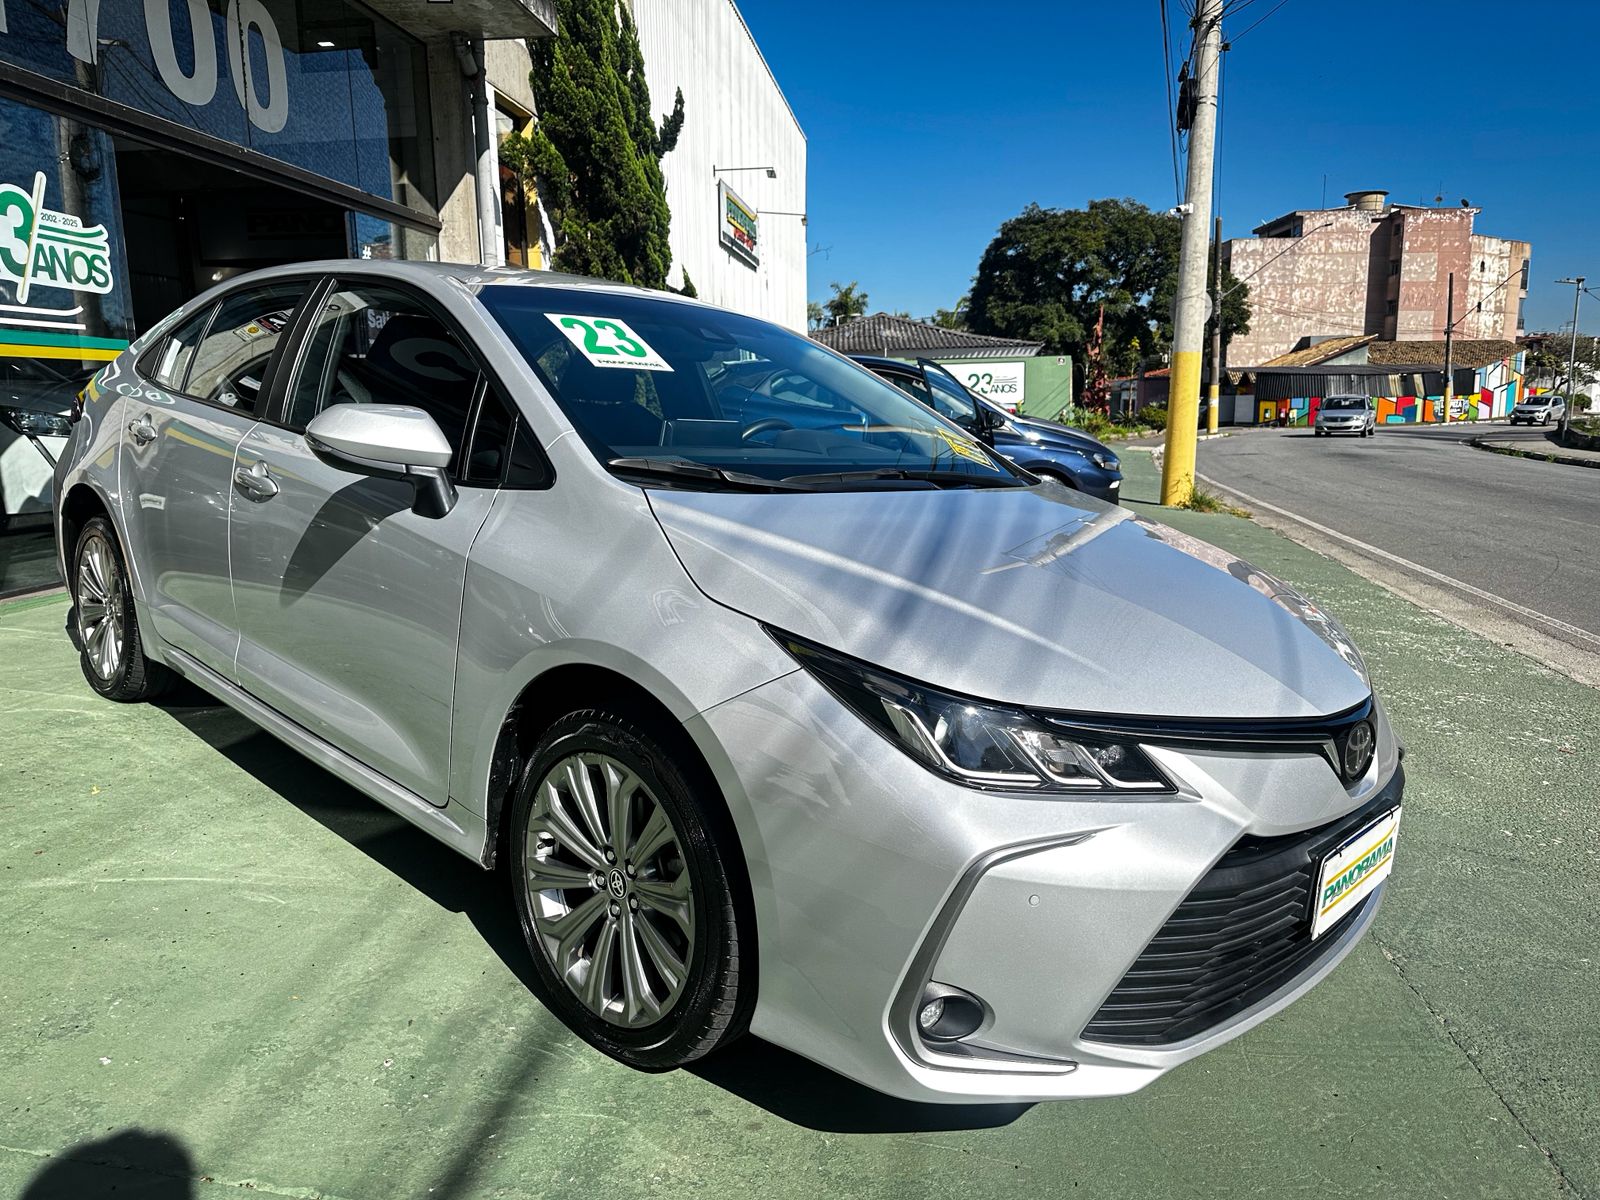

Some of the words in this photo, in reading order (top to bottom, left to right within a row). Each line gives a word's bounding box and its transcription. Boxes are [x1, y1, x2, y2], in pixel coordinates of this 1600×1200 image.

[40, 212, 57, 224] 2002
[62, 217, 78, 228] 2025
[31, 243, 110, 288] ANOS
[560, 317, 647, 358] 23
[967, 372, 993, 394] 23
[989, 383, 1018, 394] ANOS
[1321, 837, 1393, 909] PANORAMA
